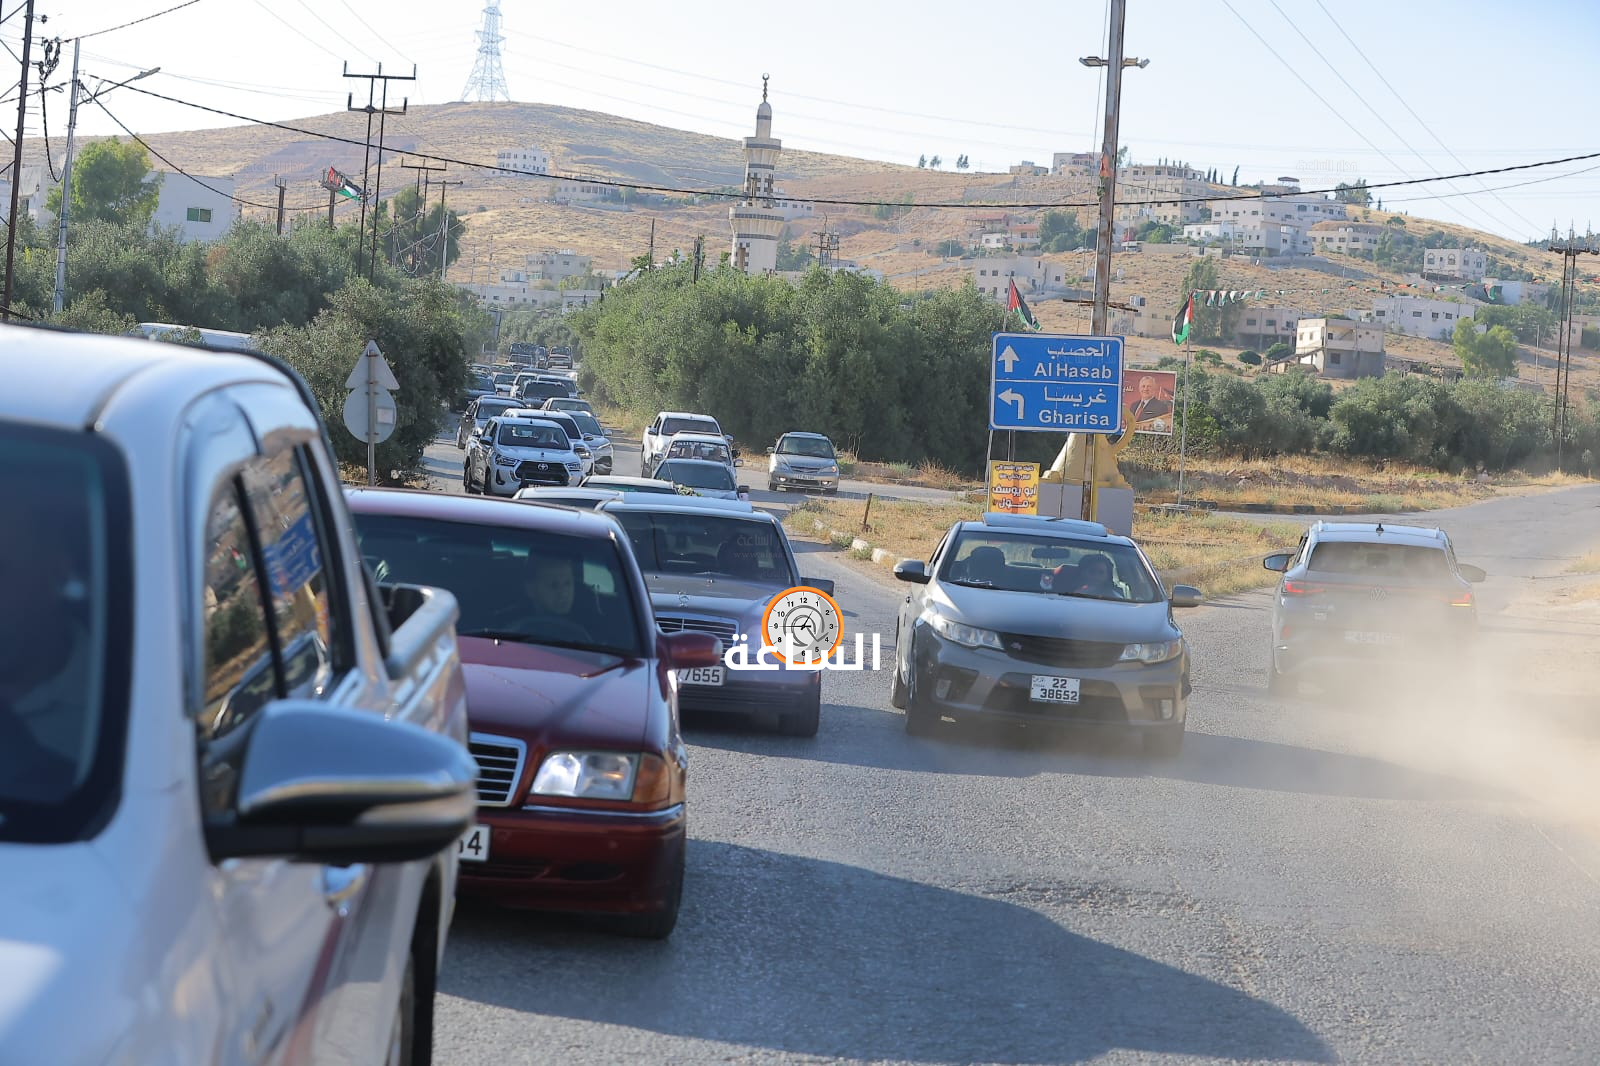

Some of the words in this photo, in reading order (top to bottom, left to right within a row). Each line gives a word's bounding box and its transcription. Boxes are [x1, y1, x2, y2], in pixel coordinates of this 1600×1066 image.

[1034, 362, 1052, 377] Al
[1056, 363, 1112, 379] Hasab
[1044, 386, 1107, 407] غريسا
[1039, 409, 1110, 426] Gharisa
[991, 484, 1022, 497] يوسف
[1052, 678, 1067, 688] 22
[1040, 688, 1078, 701] 38652
[459, 830, 483, 855] 4
